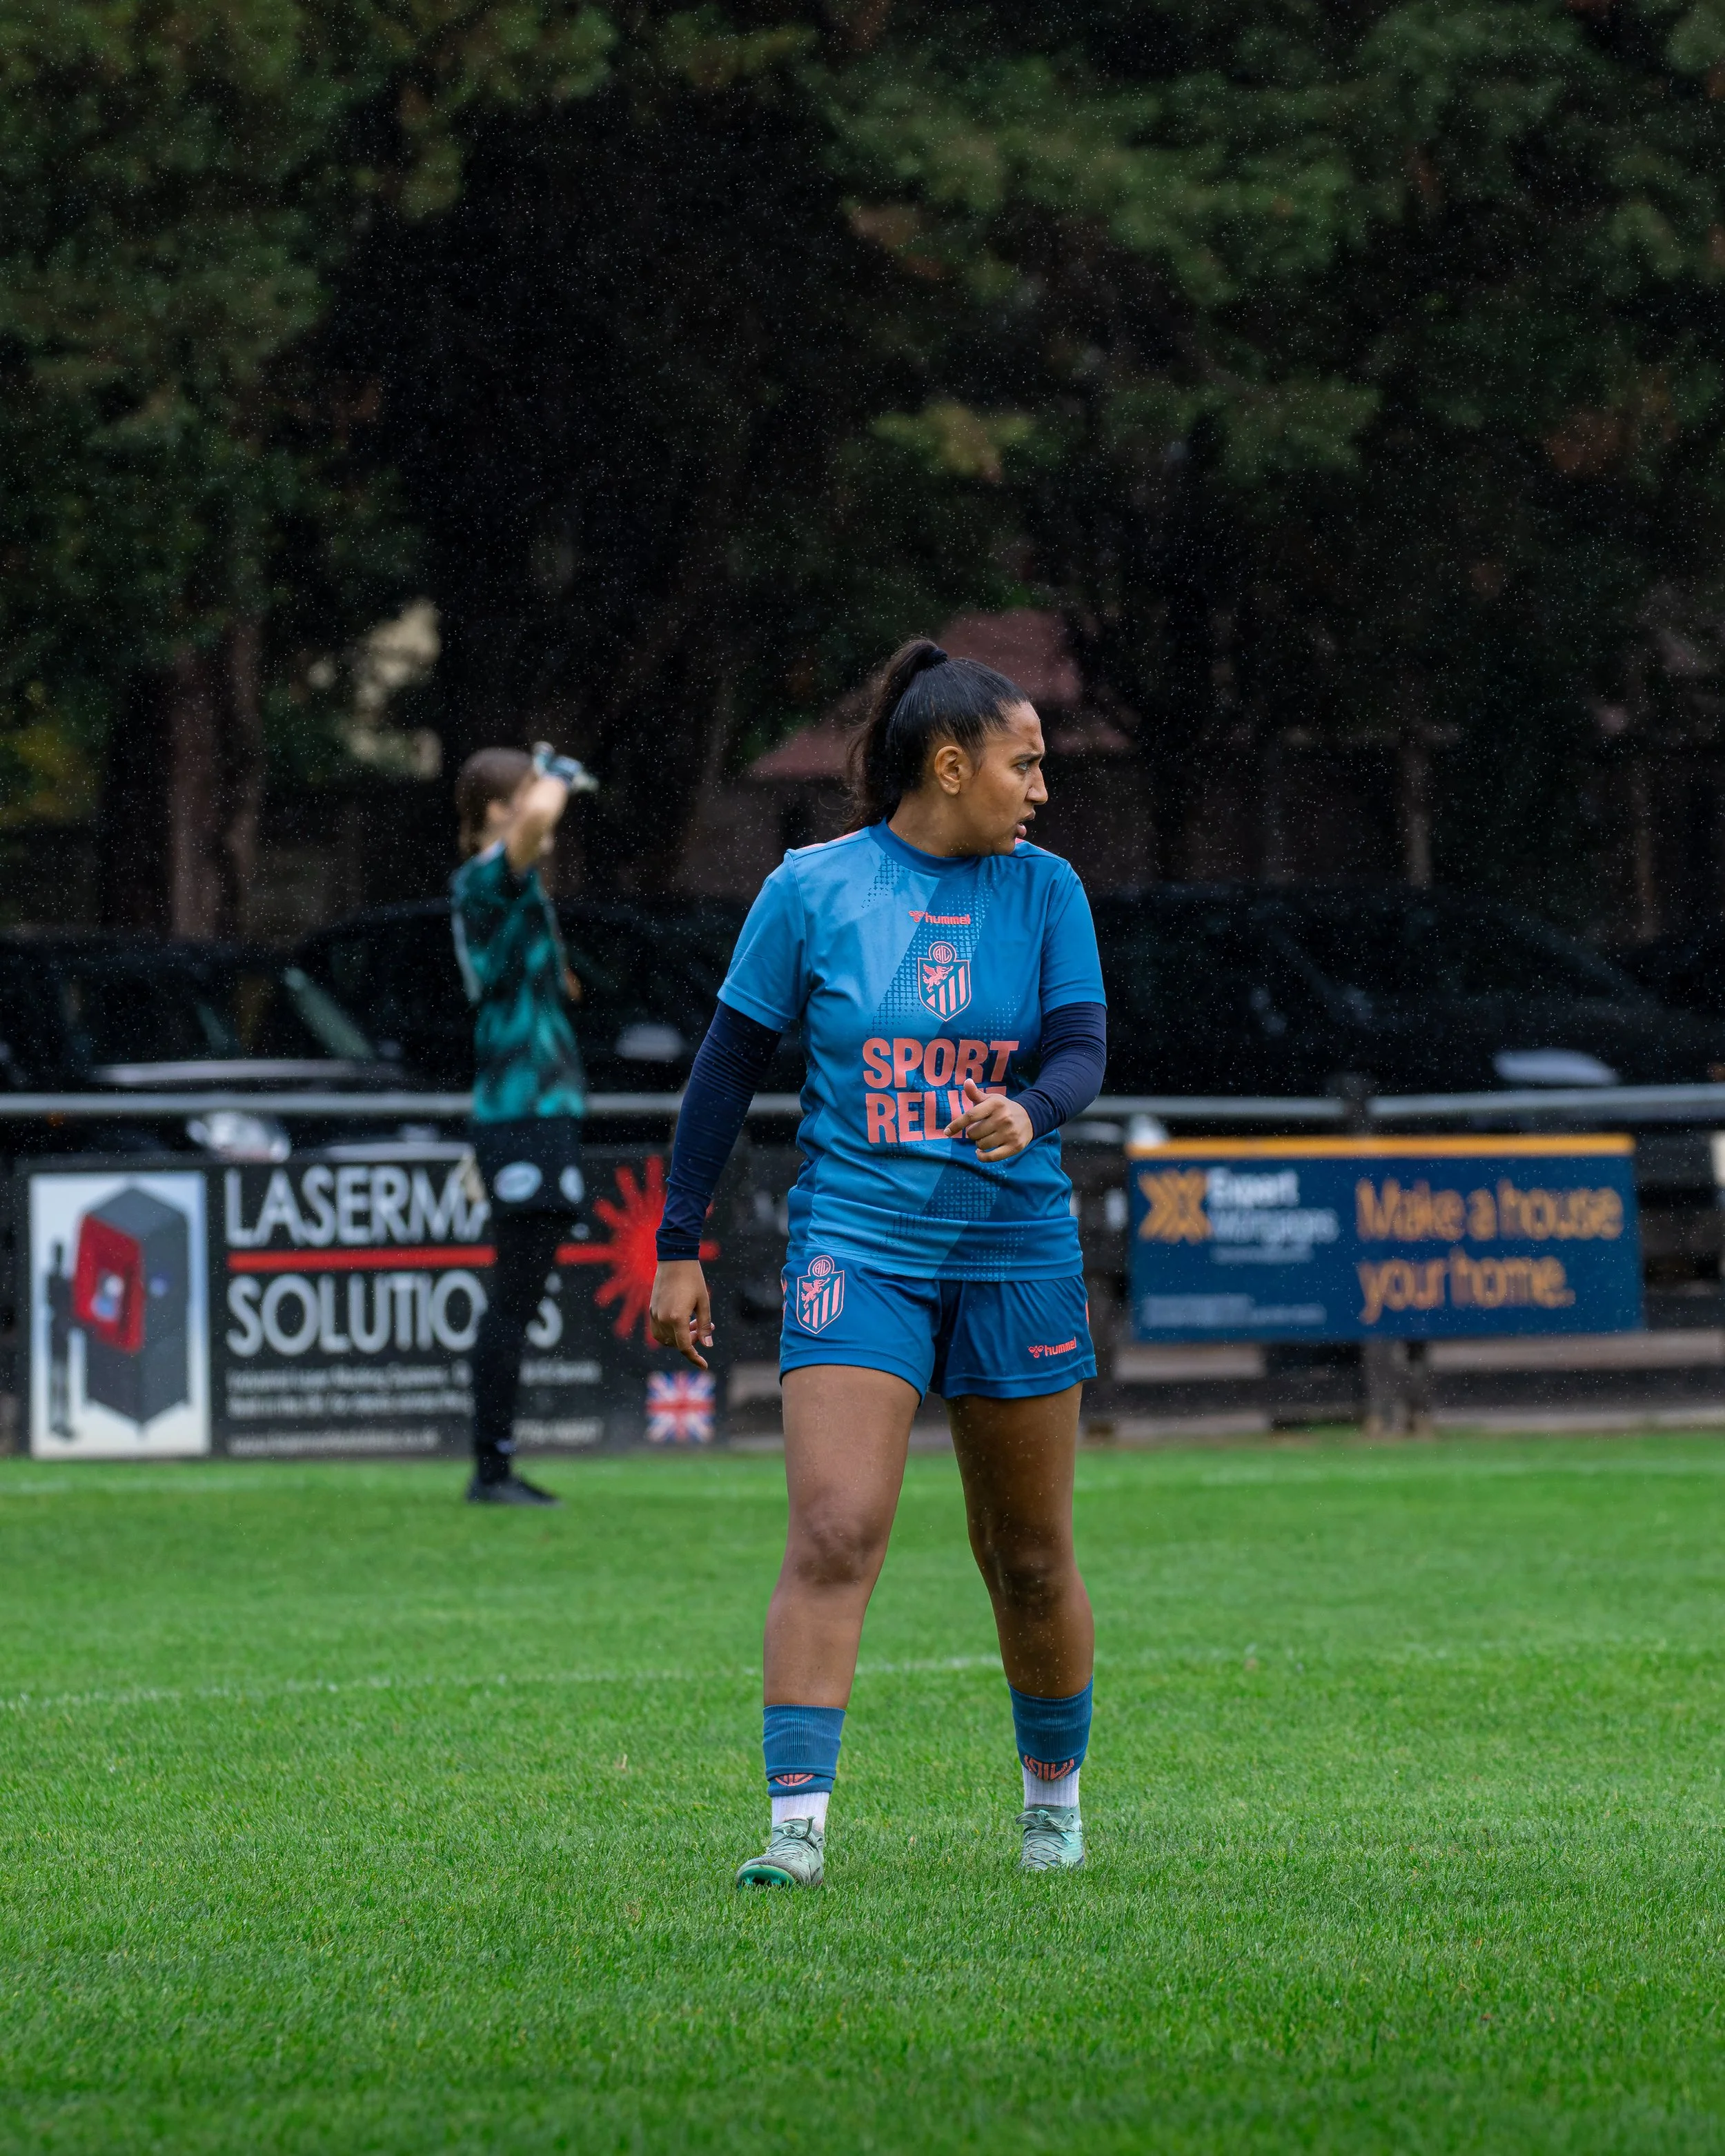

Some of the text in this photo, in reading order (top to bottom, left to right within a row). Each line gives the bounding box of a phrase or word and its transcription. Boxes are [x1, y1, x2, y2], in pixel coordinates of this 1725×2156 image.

[925, 911, 971, 925] hummel
[862, 1037, 1020, 1089] SPORT
[865, 1085, 1007, 1144] RELI
[1355, 1177, 1624, 1241] Make a house
[226, 1268, 563, 1358] SOLUTIOS
[1357, 1258, 1447, 1325] your
[1044, 1336, 1077, 1357] hummel
